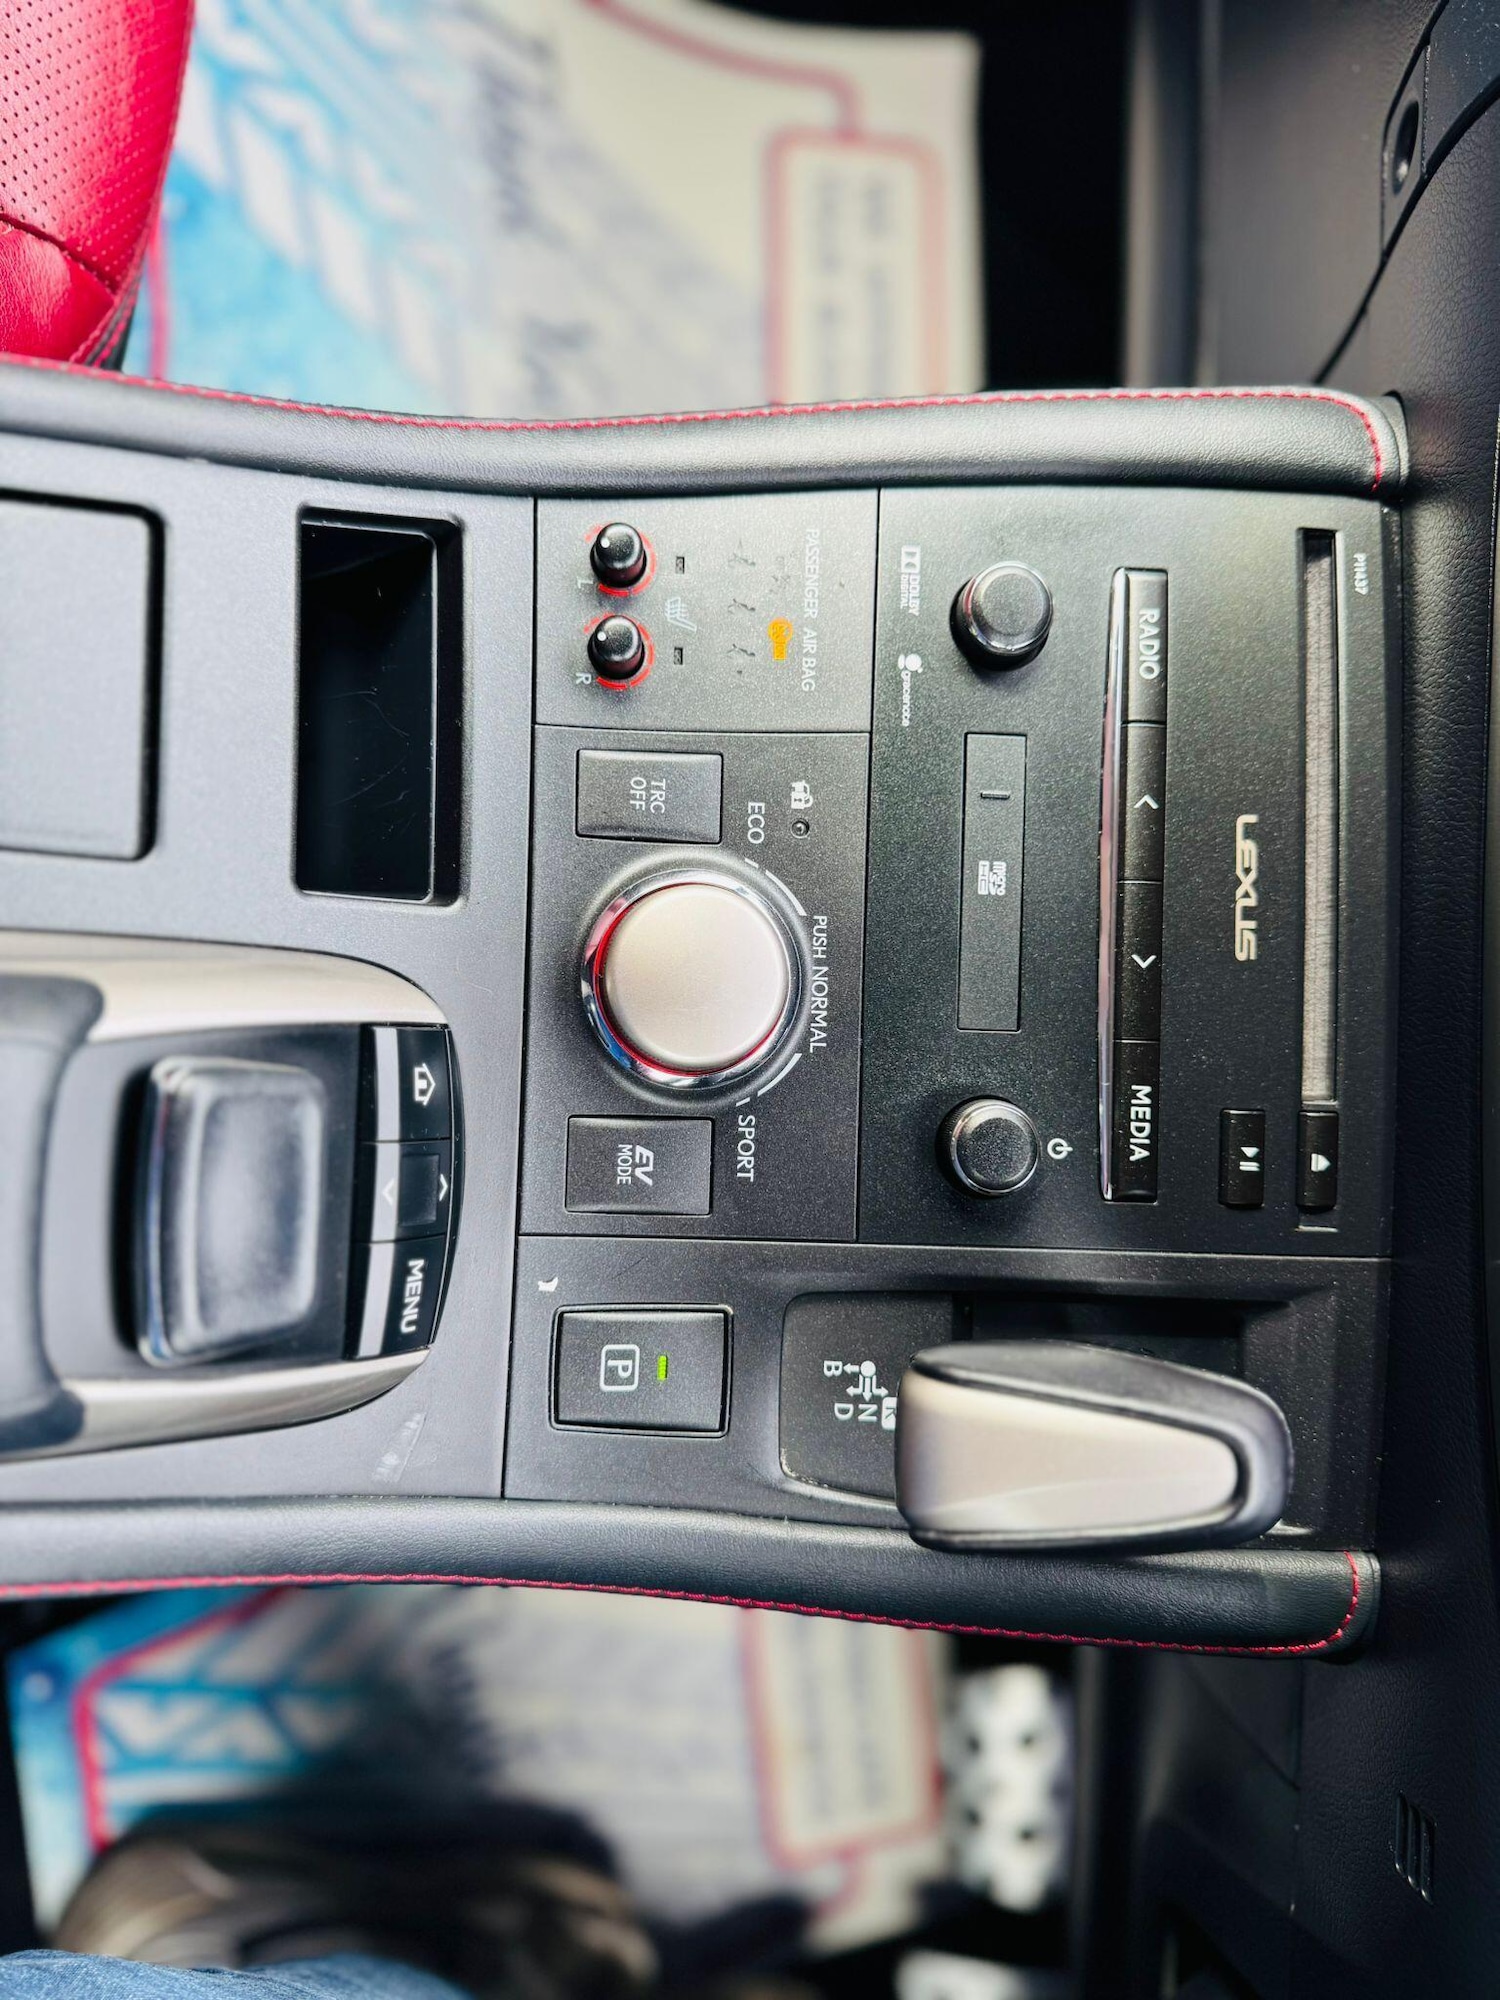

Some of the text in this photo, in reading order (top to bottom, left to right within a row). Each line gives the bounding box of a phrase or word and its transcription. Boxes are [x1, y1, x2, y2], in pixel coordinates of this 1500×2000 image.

[802, 529, 819, 692] PASSENGER AIR BAG
[900, 574, 909, 610] DIGITAL
[909, 574, 920, 616] DOLBY
[1138, 608, 1160, 680] RADIO
[576, 672, 592, 685] R
[900, 670, 911, 727] gracenote
[630, 777, 646, 811] OFF
[650, 778, 666, 815] TRC
[747, 800, 766, 845] ECO
[1234, 814, 1259, 962] LEXUS
[809, 915, 829, 1053] PUSH NORMAL
[1128, 1084, 1153, 1162] MEDIA
[616, 1144, 633, 1185] MODE
[635, 1144, 654, 1186] EV
[736, 1115, 756, 1182] SPORT
[400, 1258, 425, 1334] MENU
[606, 1359, 633, 1380] P
[823, 1360, 843, 1378] B
[834, 1402, 854, 1421] D
[858, 1403, 878, 1422] N
